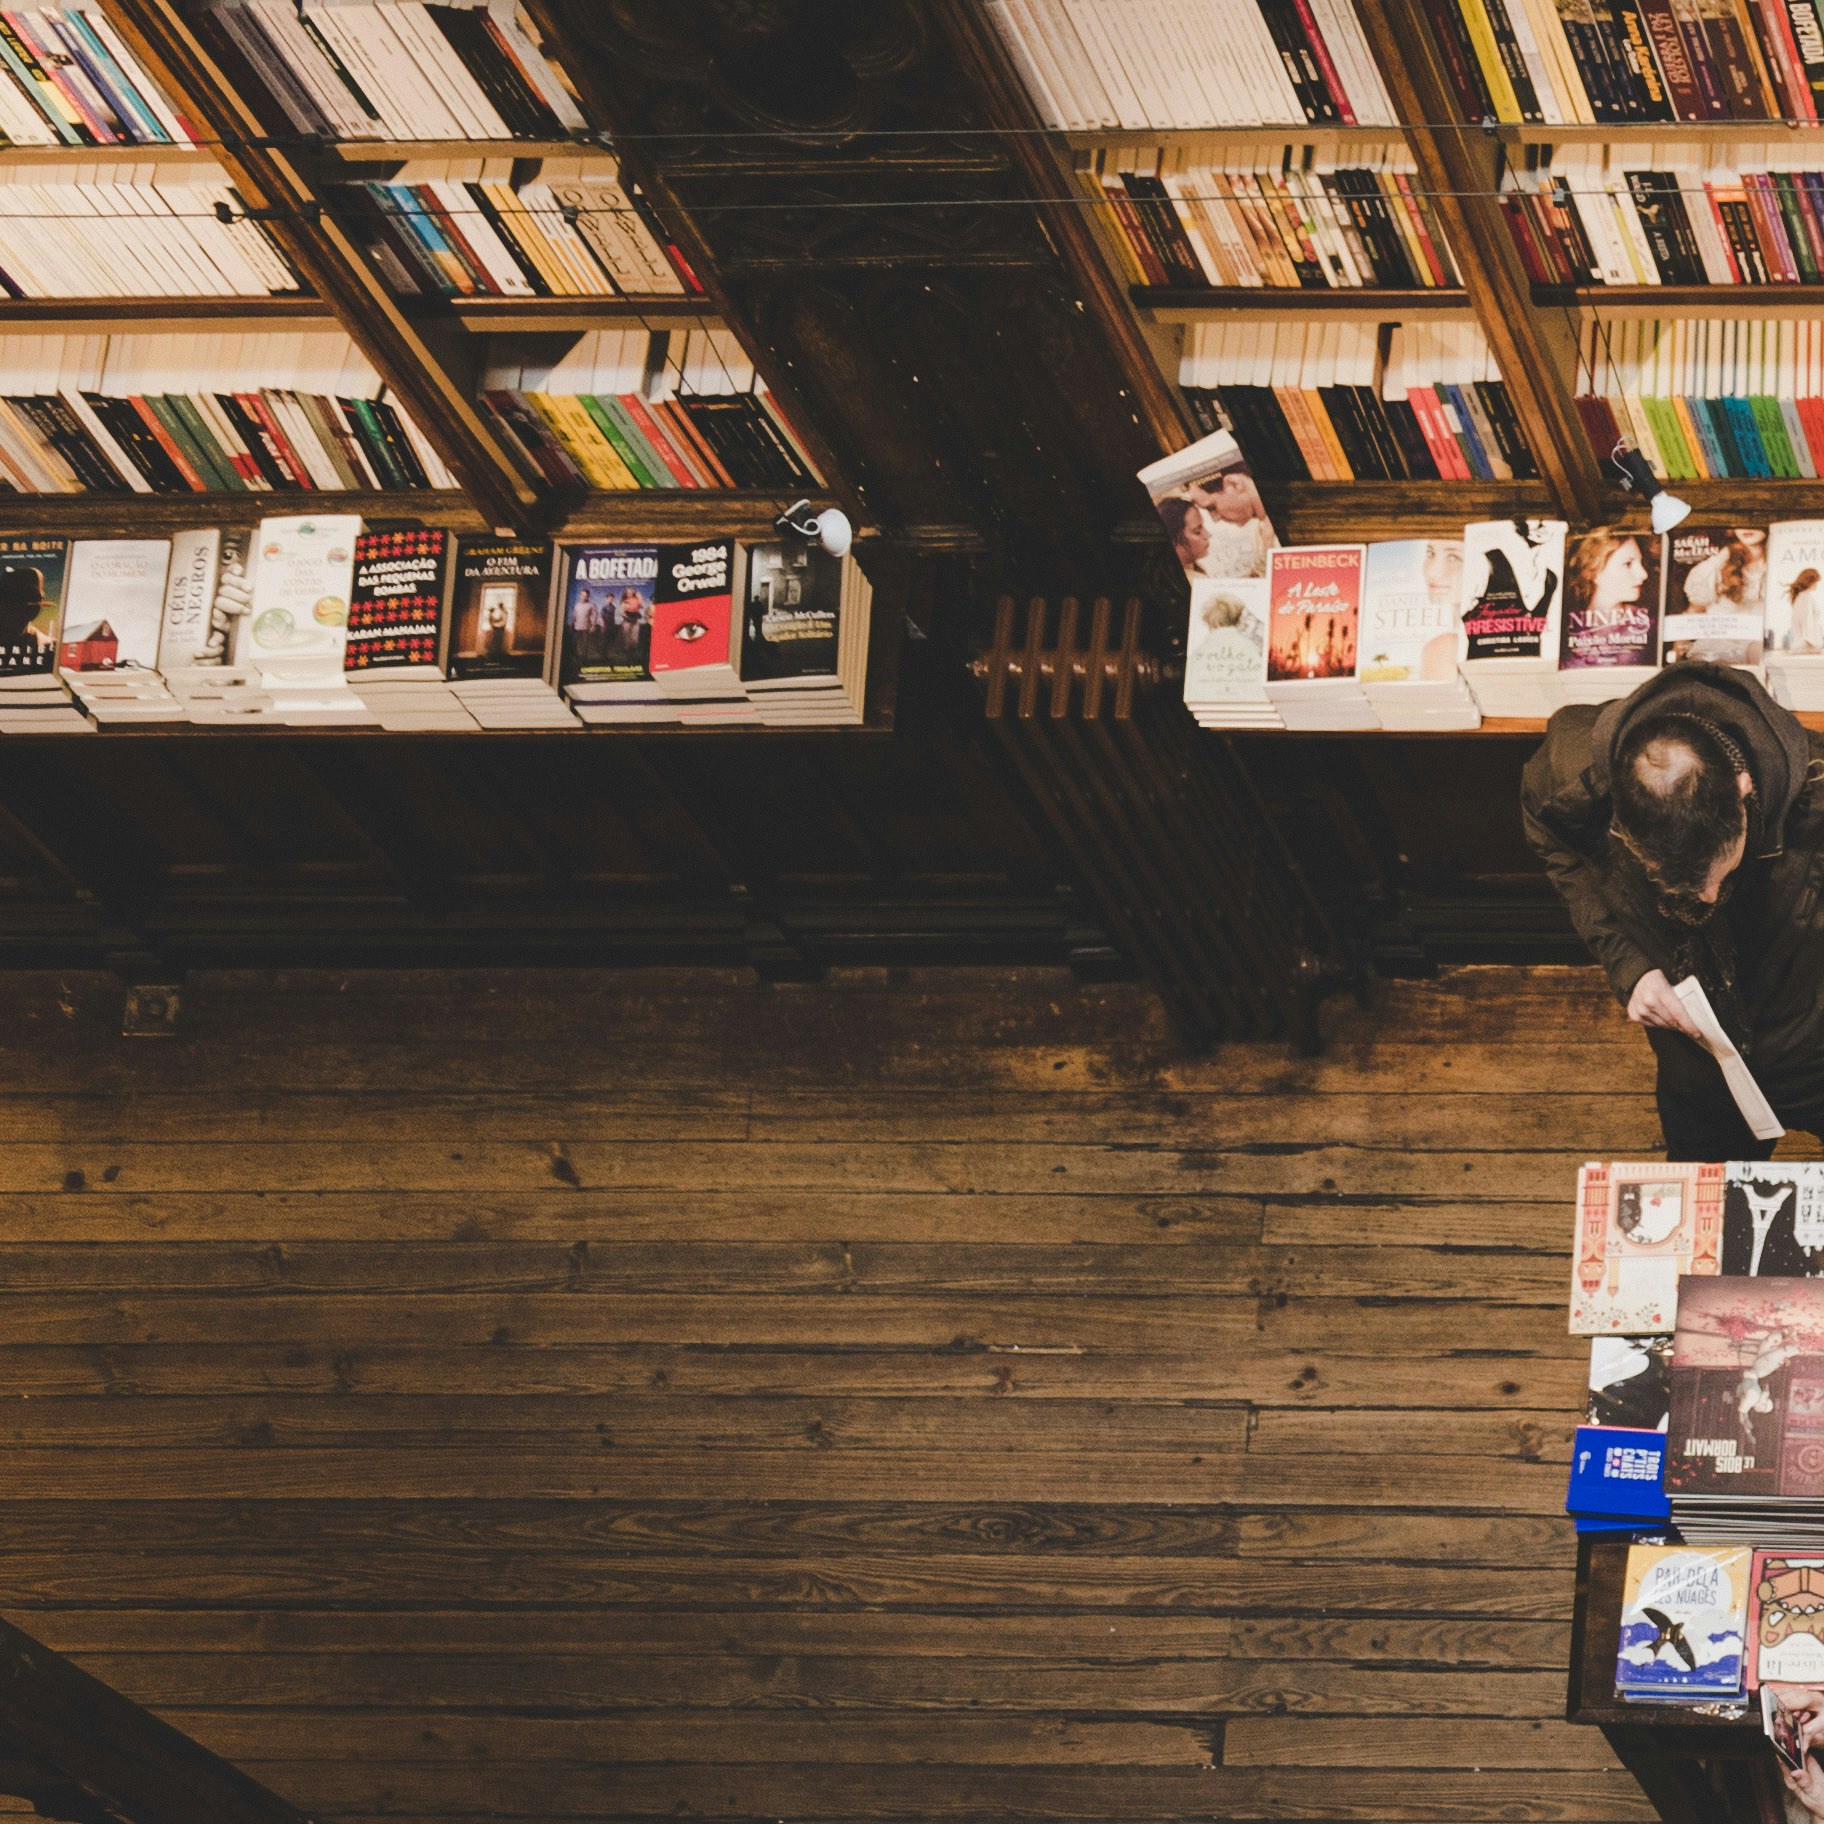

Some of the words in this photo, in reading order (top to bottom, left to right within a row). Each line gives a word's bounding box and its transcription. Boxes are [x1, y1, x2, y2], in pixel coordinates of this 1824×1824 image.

[692, 547, 727, 562] 1984
[1273, 554, 1360, 570] STEINBECK
[575, 558, 587, 578] A
[671, 561, 727, 580] George
[678, 576, 726, 593] Orwell
[1374, 607, 1446, 630] STEEL
[1568, 608, 1649, 633] NINFAS
[1683, 1439, 1737, 1457] DORMAIT
[1620, 1447, 1635, 1480] CHATS
[1645, 1449, 1661, 1481] TROIS
[1715, 1456, 1742, 1473] BOIS
